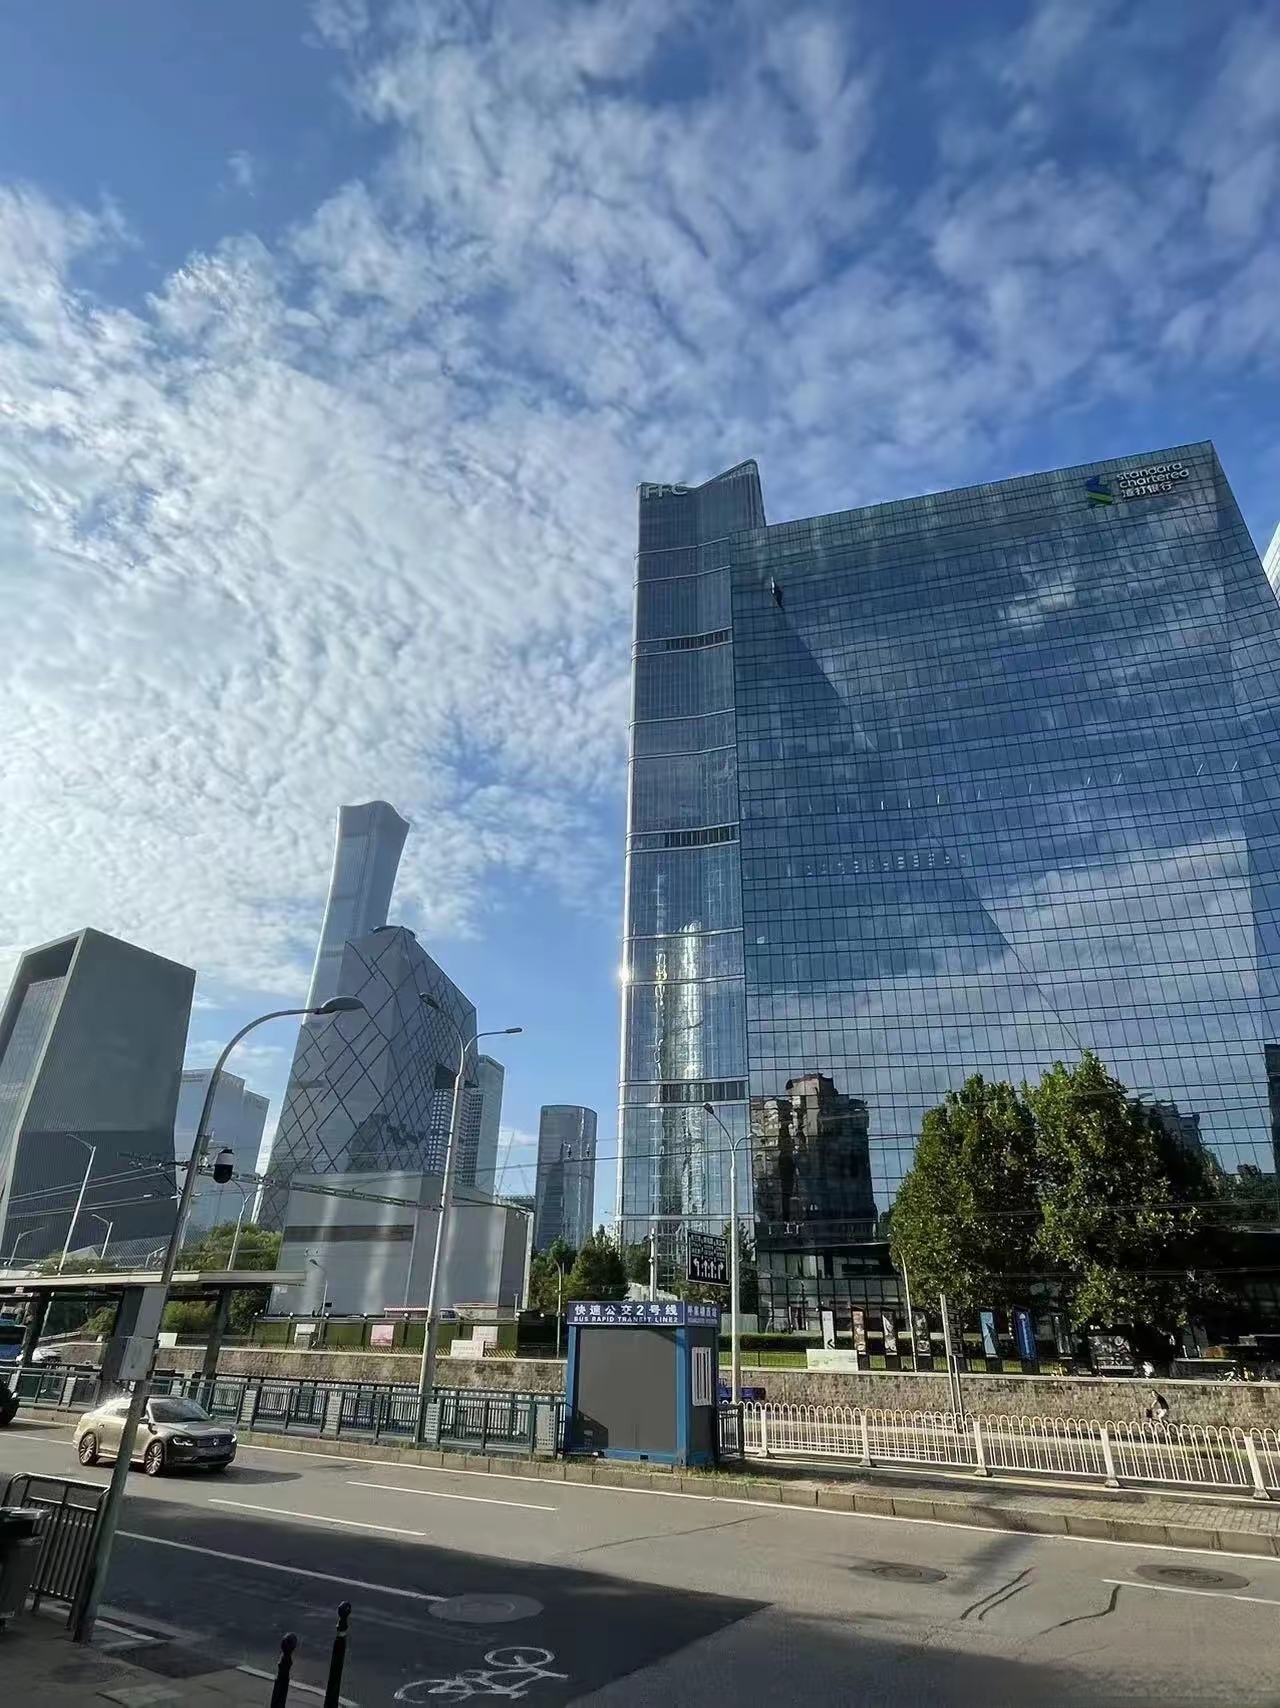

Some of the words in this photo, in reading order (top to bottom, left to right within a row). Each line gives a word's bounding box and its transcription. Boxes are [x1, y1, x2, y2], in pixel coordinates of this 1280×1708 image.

[1120, 468, 1189, 489] chartered
[574, 1304, 678, 1316] 快速公交2号线
